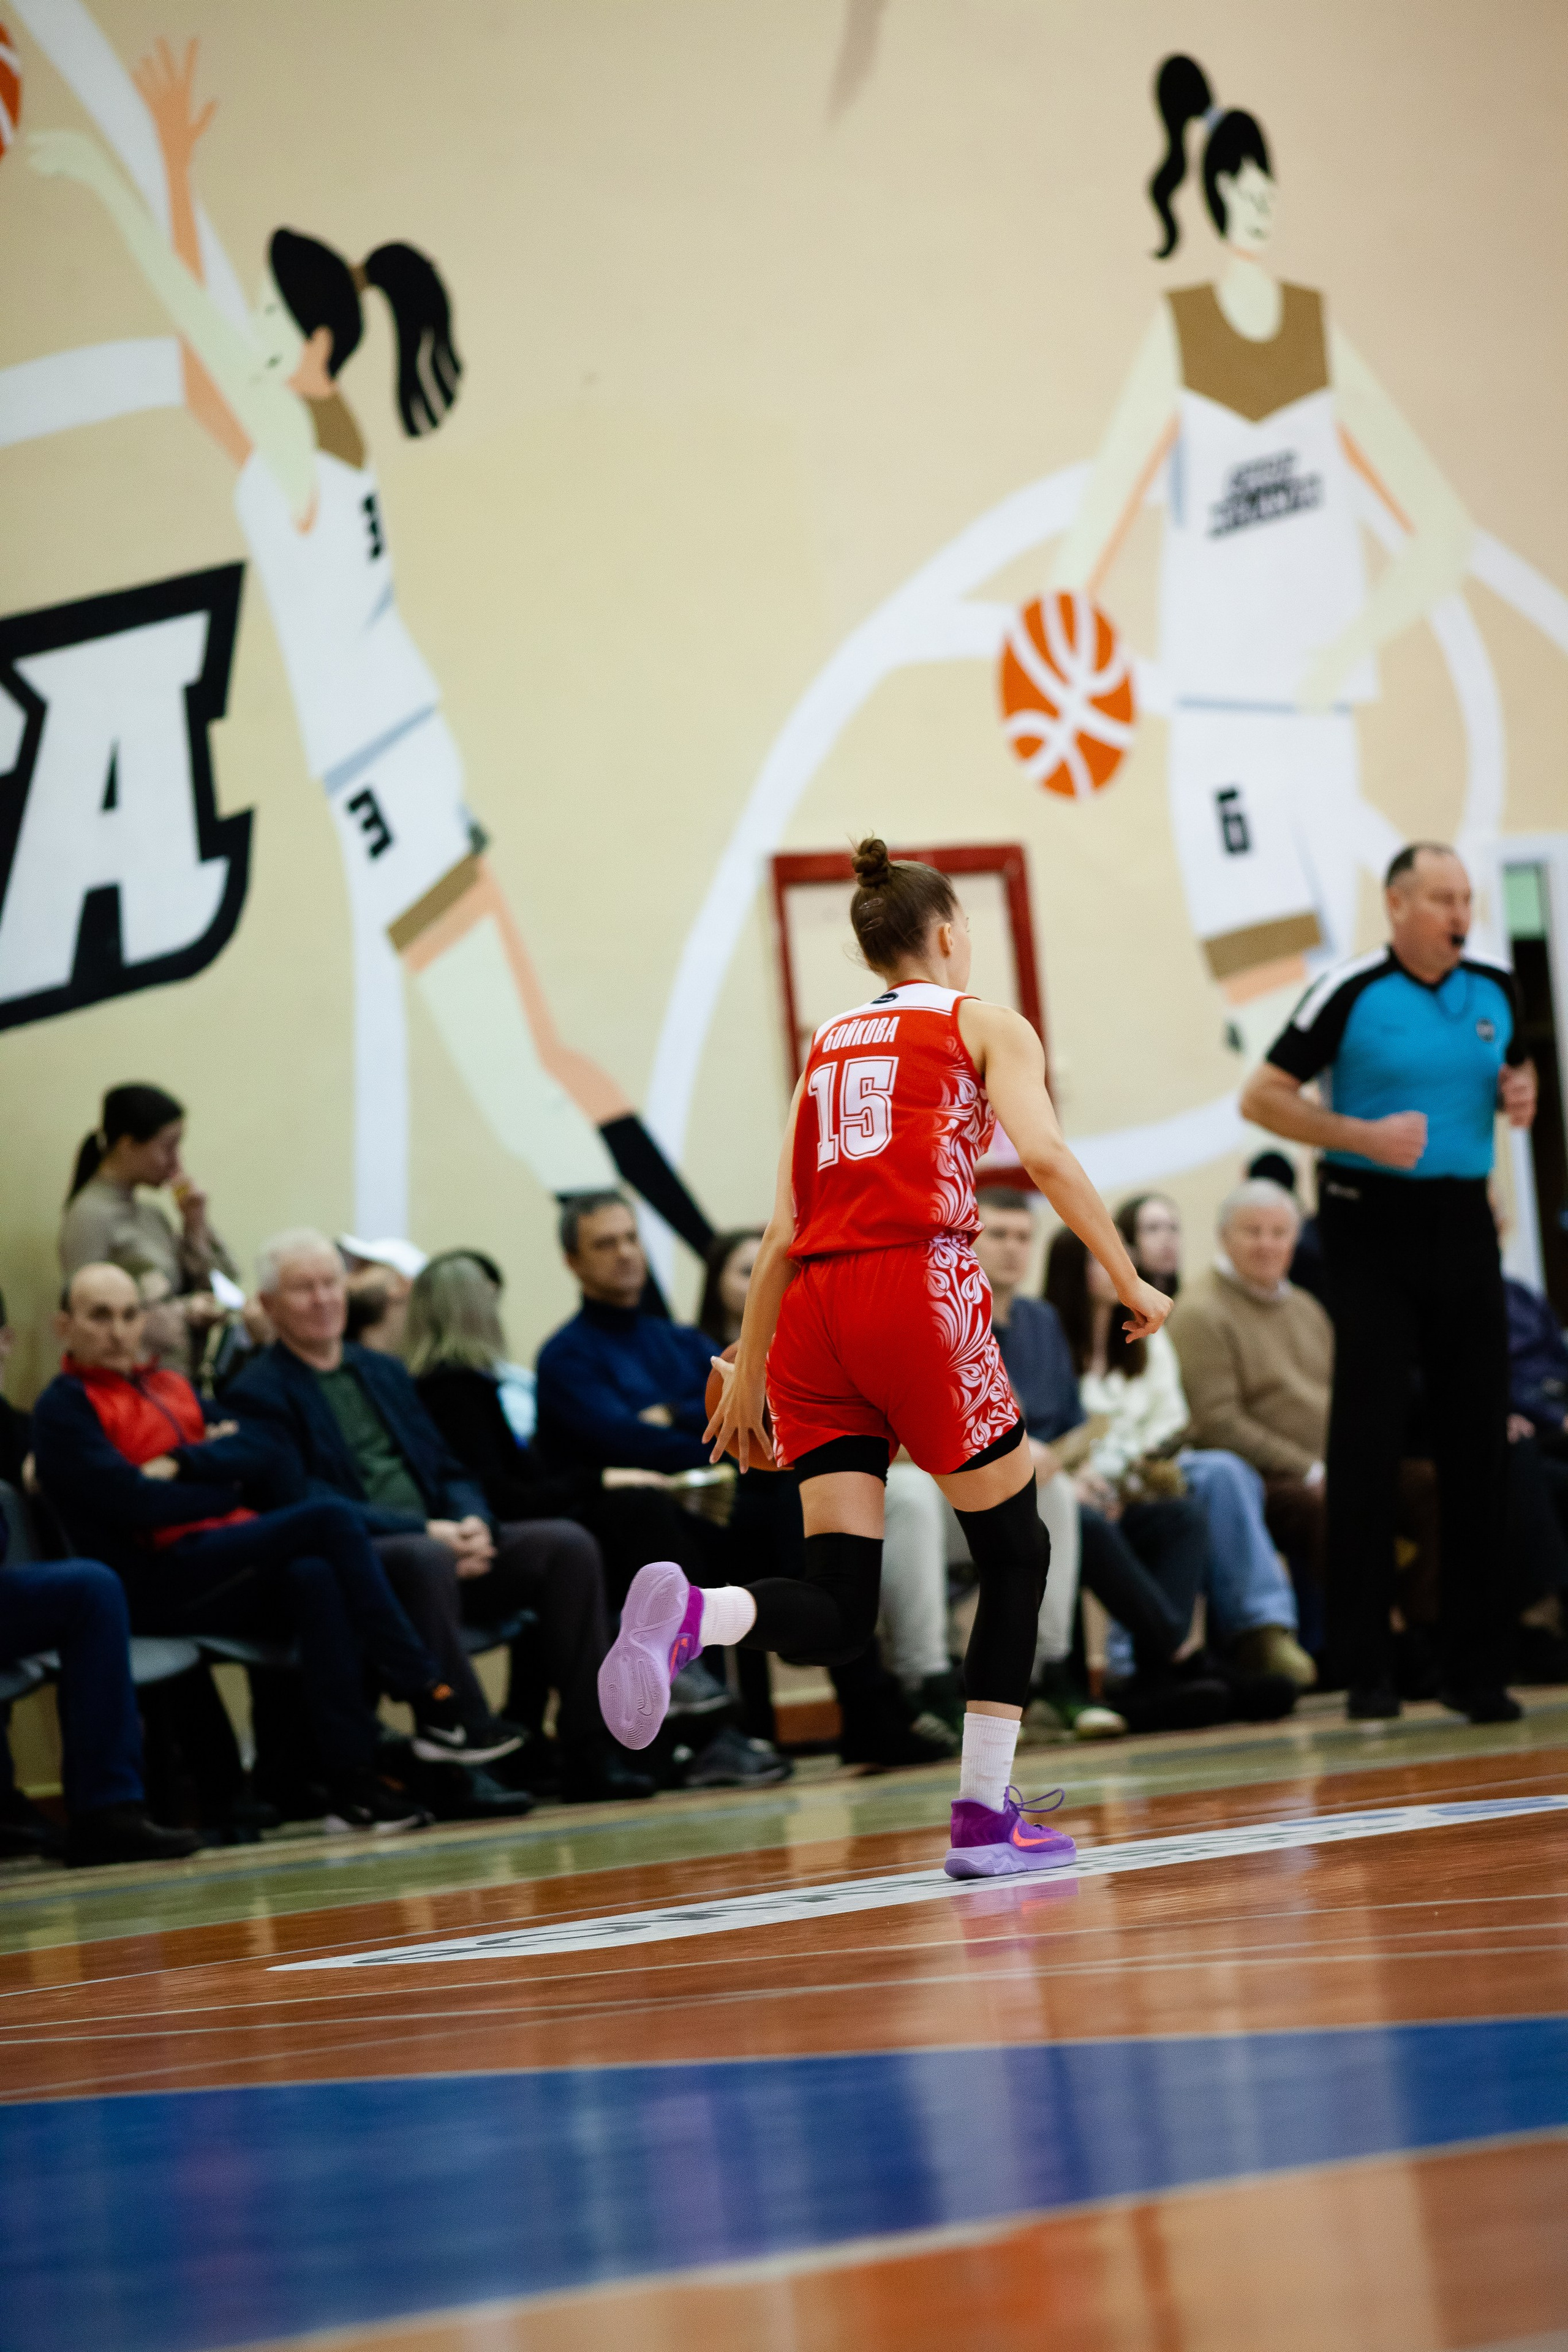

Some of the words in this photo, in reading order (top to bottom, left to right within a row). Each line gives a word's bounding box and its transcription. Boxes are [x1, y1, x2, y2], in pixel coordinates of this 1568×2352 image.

[347, 788, 394, 859] 3
[1215, 786, 1251, 856] 6
[822, 1016, 900, 1053] БОЙКОВА
[807, 1056, 899, 1172] 15
[352, 1830, 1306, 1964] ПЕЕКИСЬ
